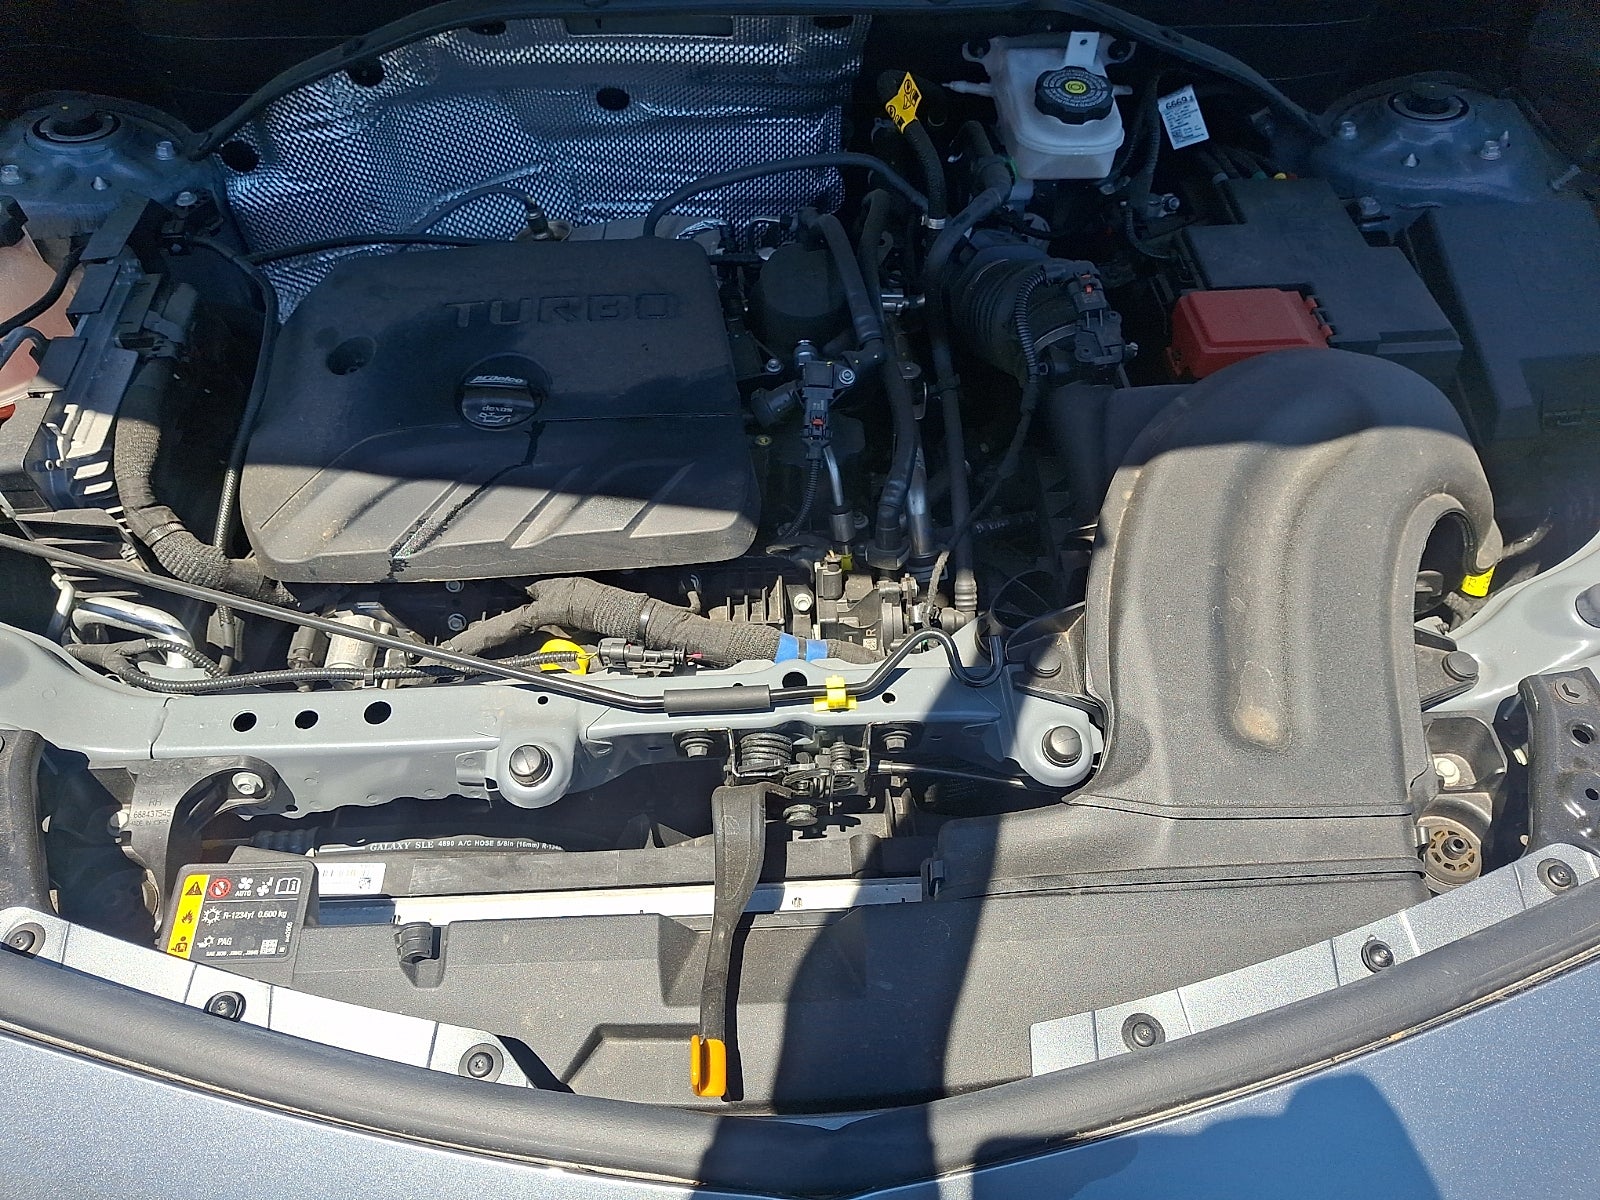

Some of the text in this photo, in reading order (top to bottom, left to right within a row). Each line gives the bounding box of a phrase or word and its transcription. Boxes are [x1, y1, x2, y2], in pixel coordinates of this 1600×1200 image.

[446, 294, 677, 328] TURBO
[482, 405, 513, 413] dexos
[370, 842, 410, 851] GALAXY
[415, 841, 434, 849] SLE
[457, 840, 472, 848] A/C
[474, 840, 495, 848] HOSE
[223, 911, 255, 920] R-1234yf
[278, 910, 288, 919] kg
[217, 937, 232, 946] PAG
